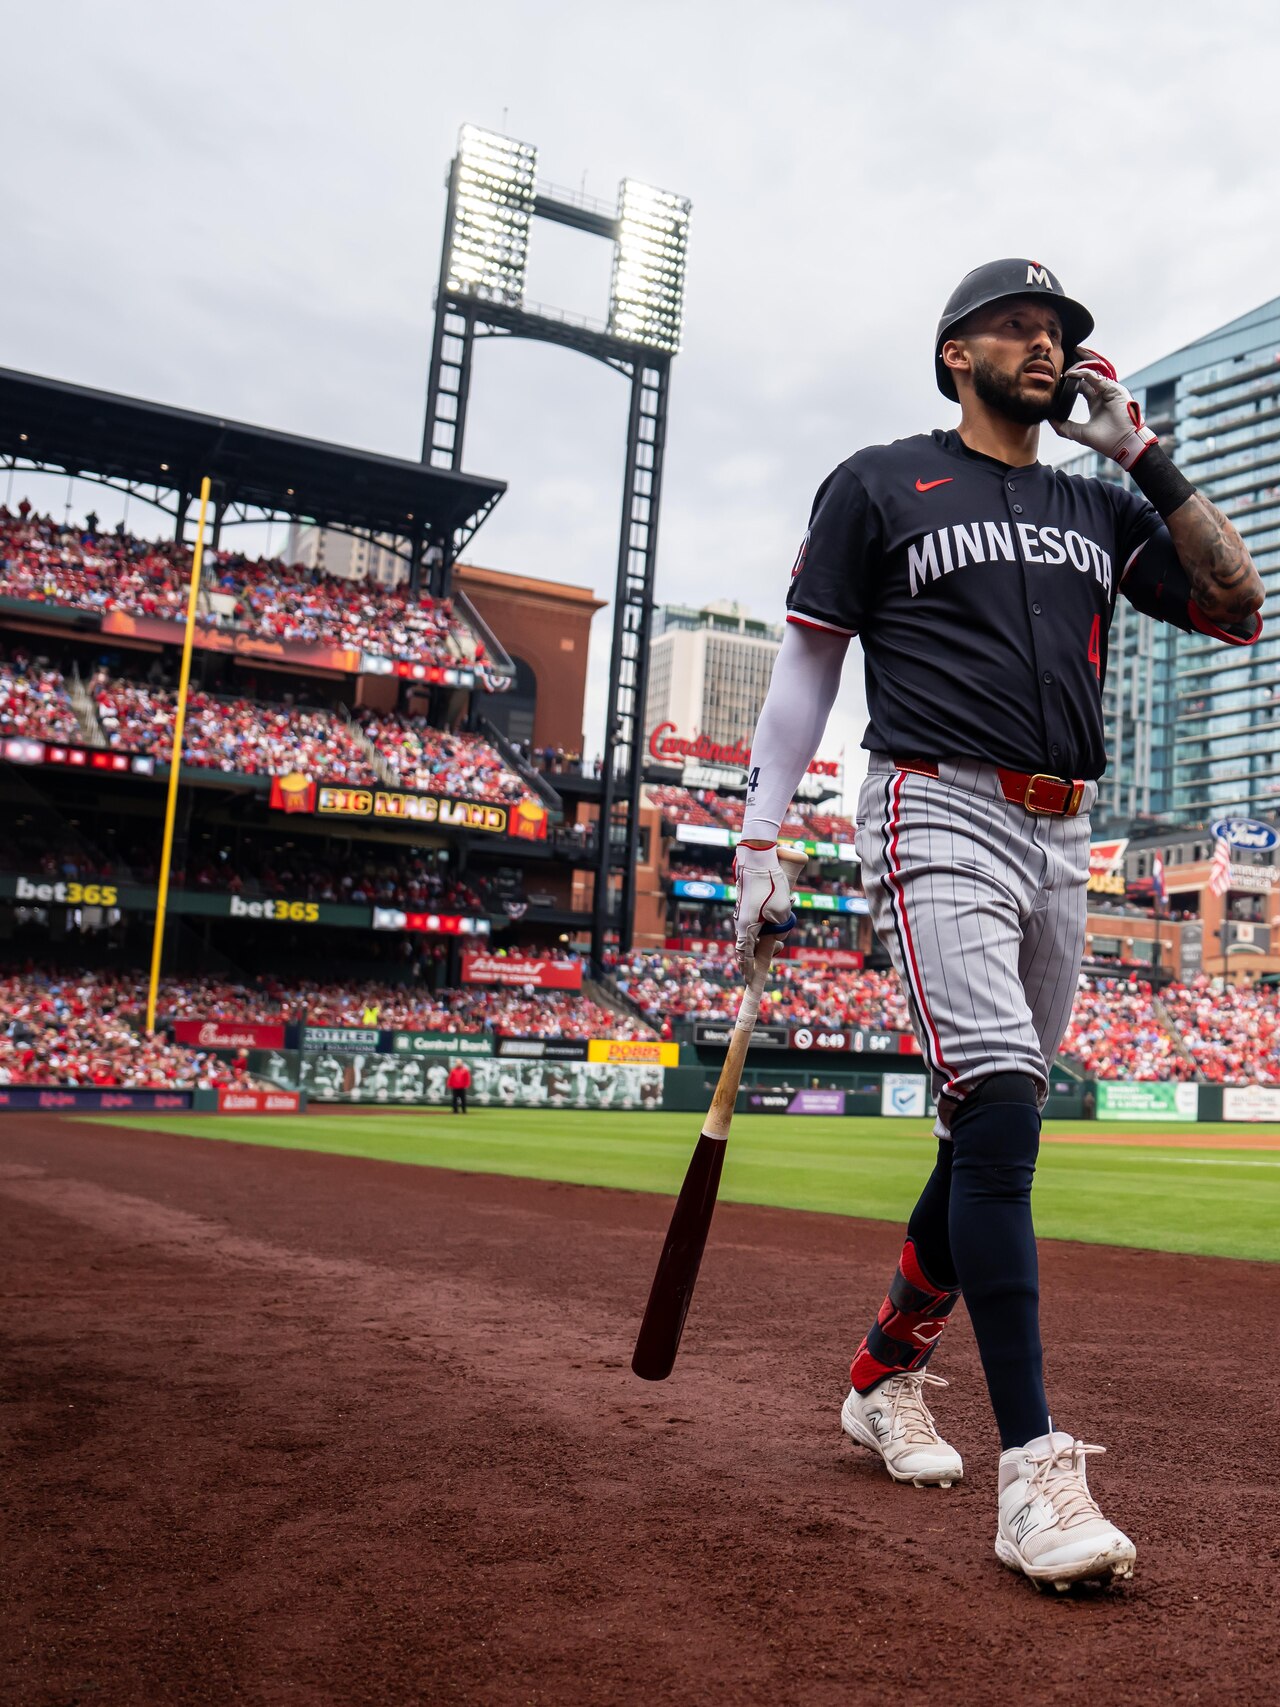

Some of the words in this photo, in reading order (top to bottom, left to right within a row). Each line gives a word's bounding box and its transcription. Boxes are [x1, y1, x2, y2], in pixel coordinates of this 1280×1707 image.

[1026, 265, 1053, 291] M
[907, 521, 1112, 604] MINNESOTA
[1087, 613, 1101, 680] 4
[318, 787, 373, 815] BIG
[373, 791, 437, 822] MAC
[438, 799, 506, 832] LAND
[16, 877, 118, 905] bet365
[229, 895, 320, 922] bet365
[414, 1037, 456, 1052] Central
[459, 1039, 491, 1053] Bank
[608, 1044, 661, 1059] DOBBS
[816, 1033, 845, 1049] 4:49
